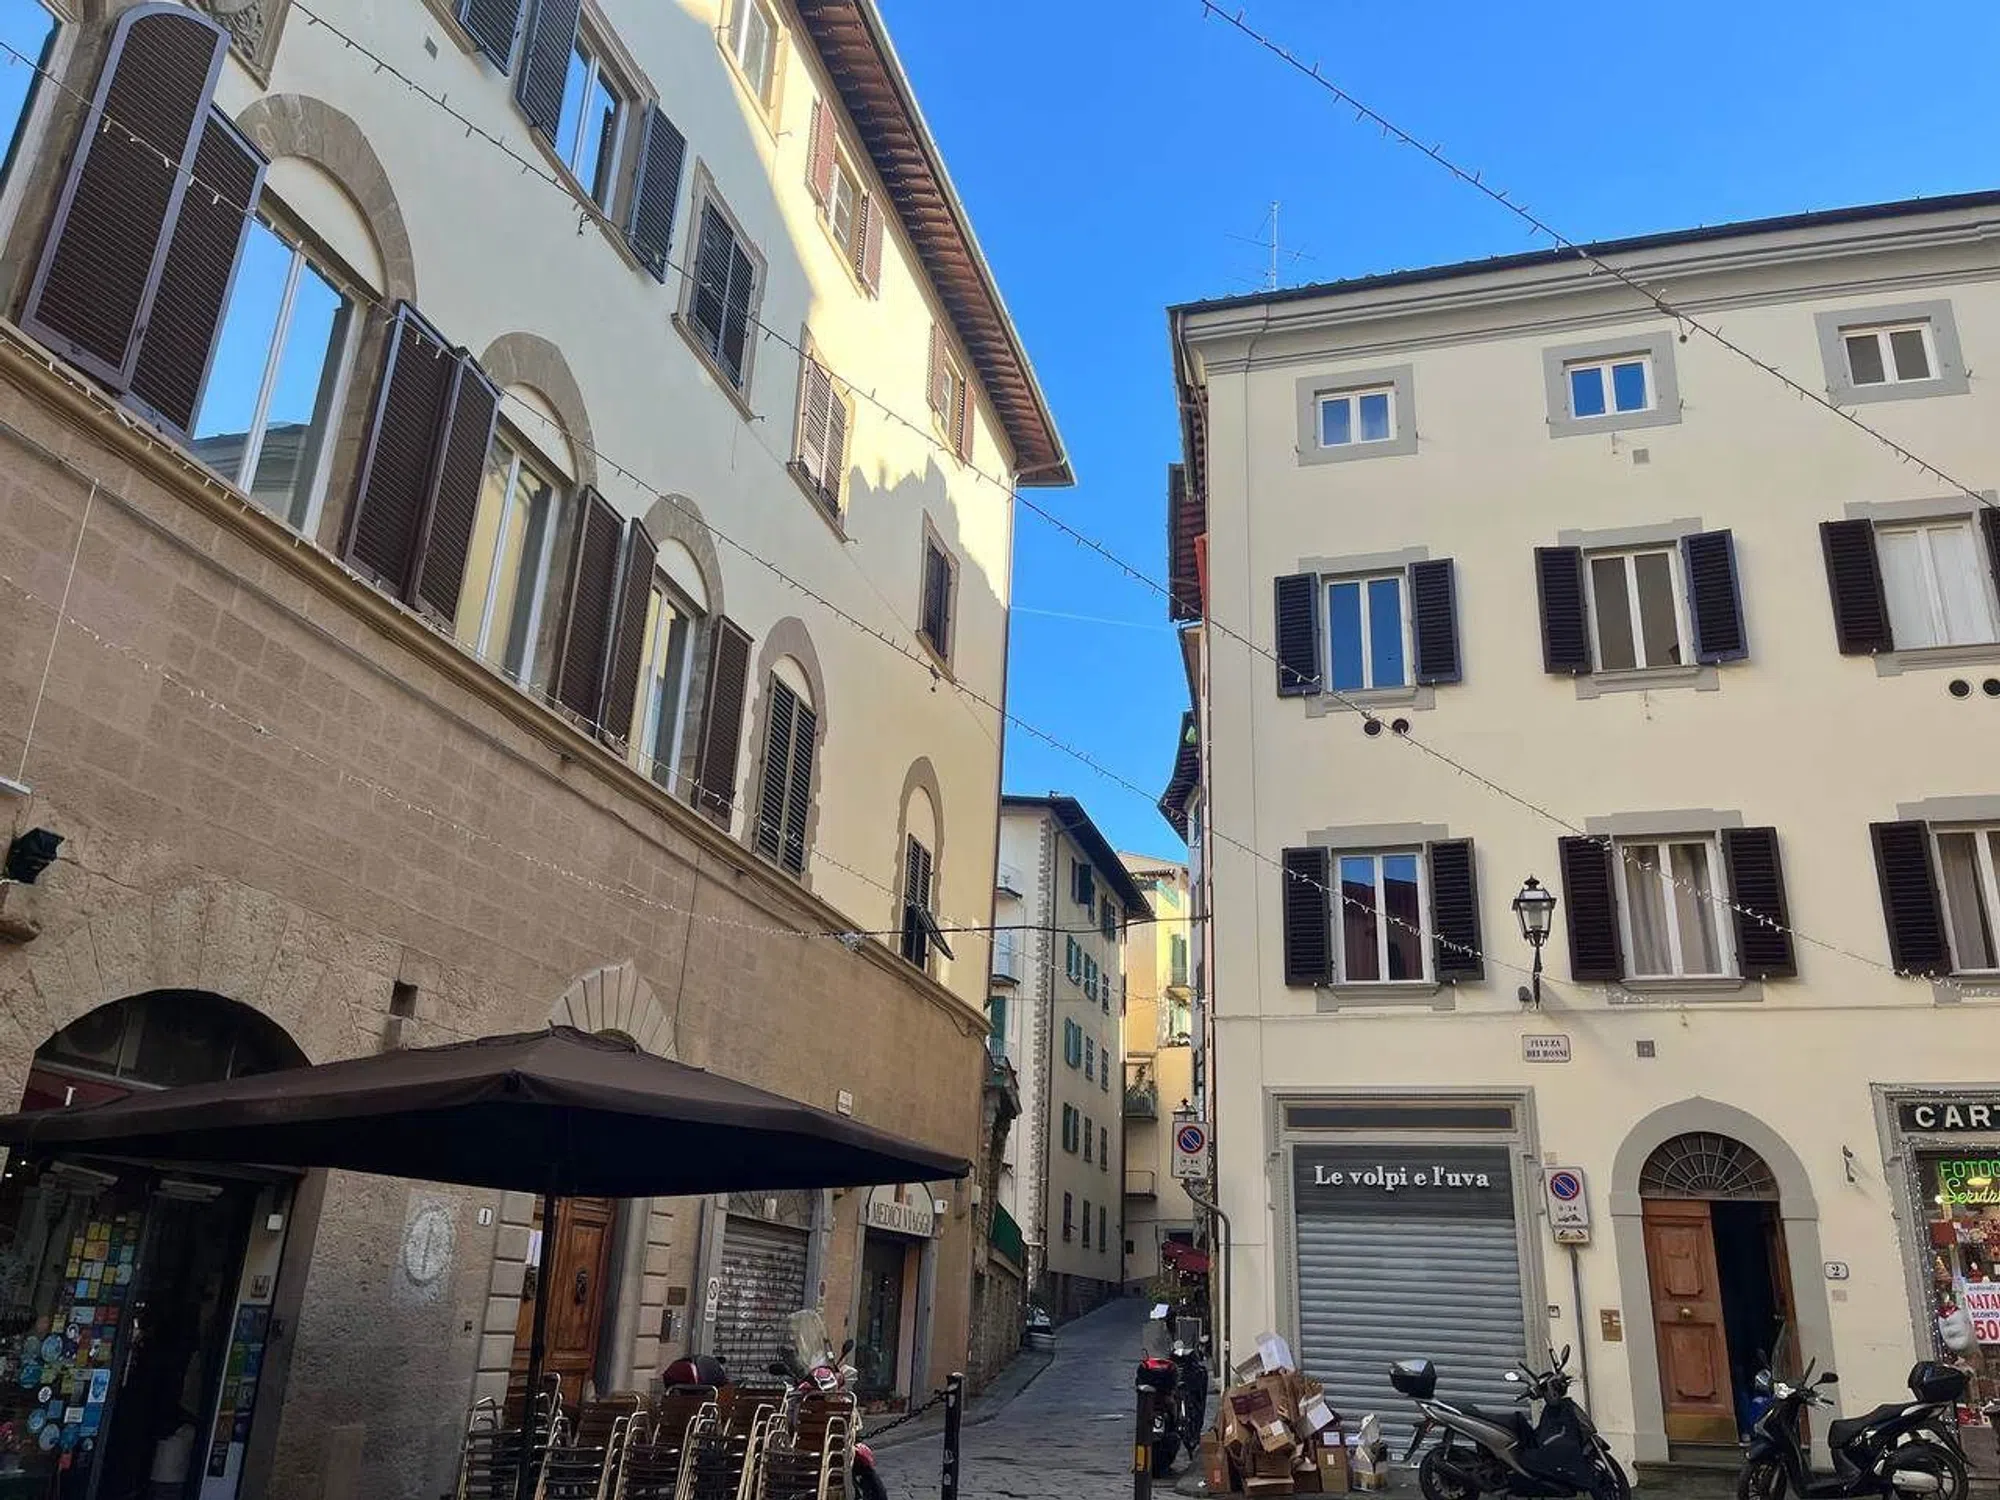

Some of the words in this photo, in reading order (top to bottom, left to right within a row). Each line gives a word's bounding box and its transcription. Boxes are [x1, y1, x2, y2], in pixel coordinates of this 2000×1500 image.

[1314, 1165, 1344, 1186] Le
[1349, 1165, 1408, 1191] volpi
[1414, 1172, 1427, 1186] e
[1432, 1166, 1490, 1188] l'uva
[1831, 1265, 1840, 1276] 2
[1966, 1293, 2000, 1309] NATA
[1974, 1319, 2000, 1340] 50
